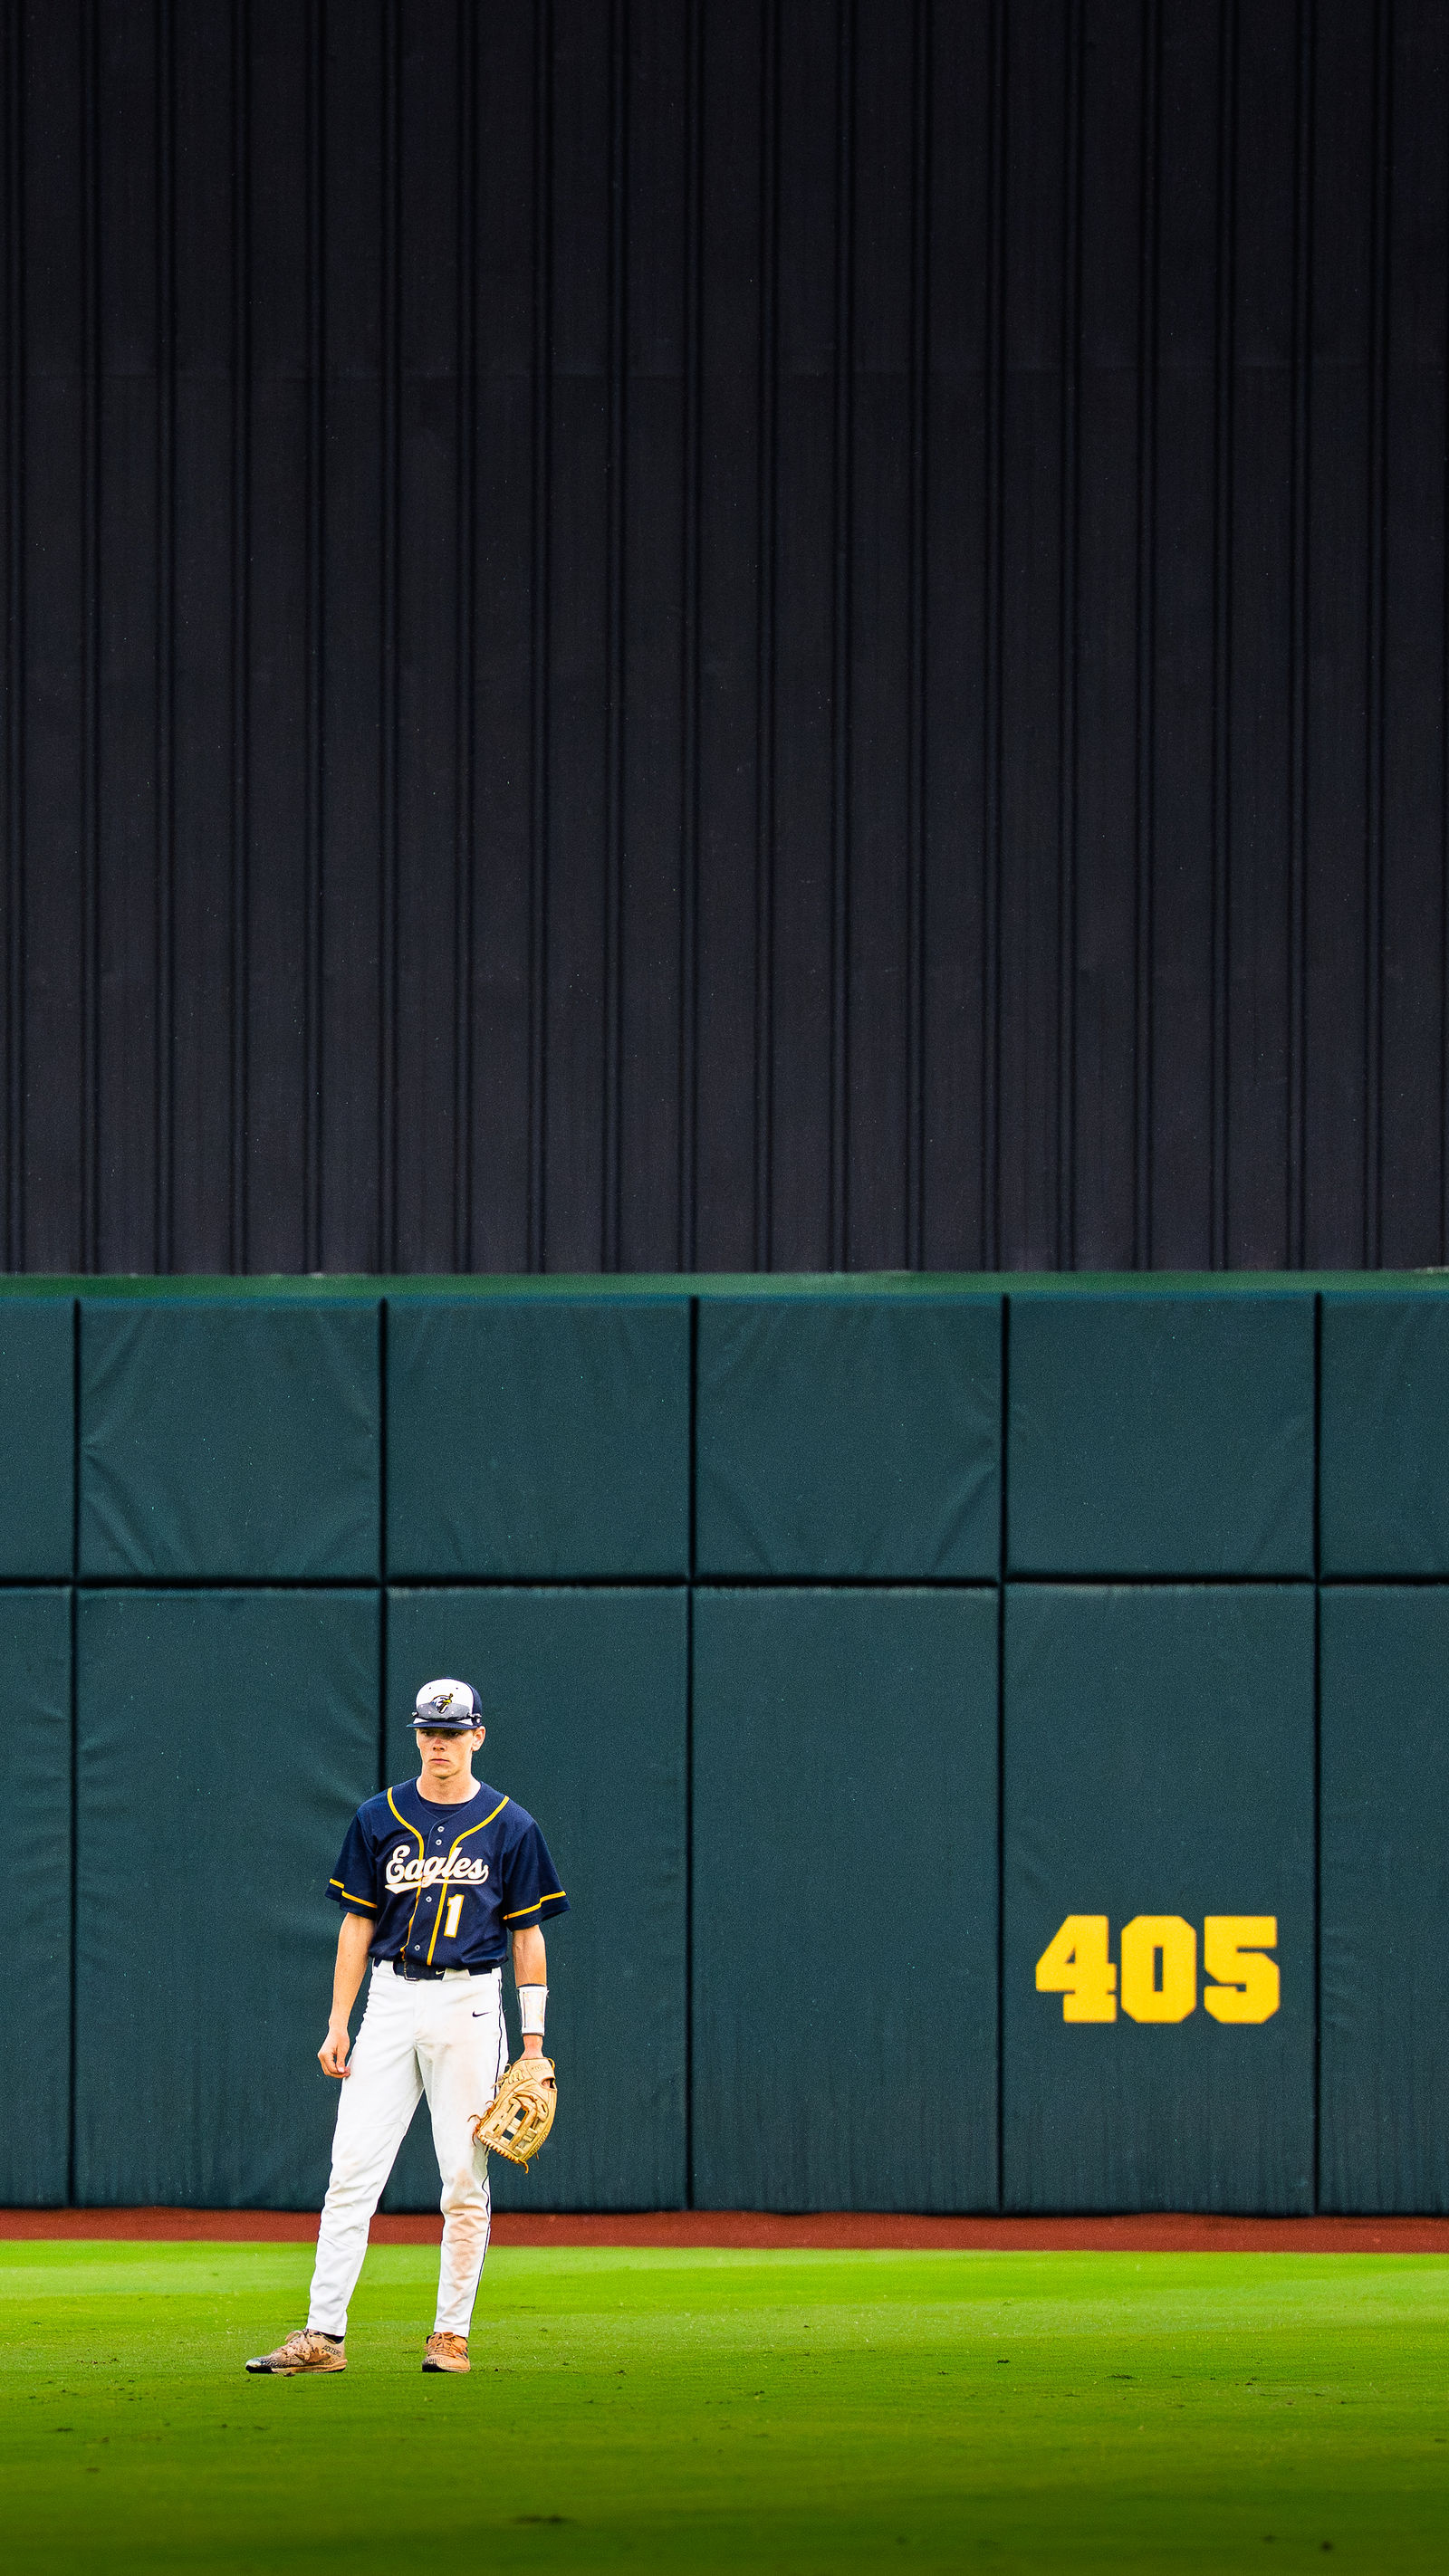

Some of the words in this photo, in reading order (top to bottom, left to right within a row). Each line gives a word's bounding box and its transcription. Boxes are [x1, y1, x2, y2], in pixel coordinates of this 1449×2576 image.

[385, 1844, 489, 1894] Eagles
[444, 1894, 465, 1938] 1
[1035, 1914, 1281, 2024] 405
